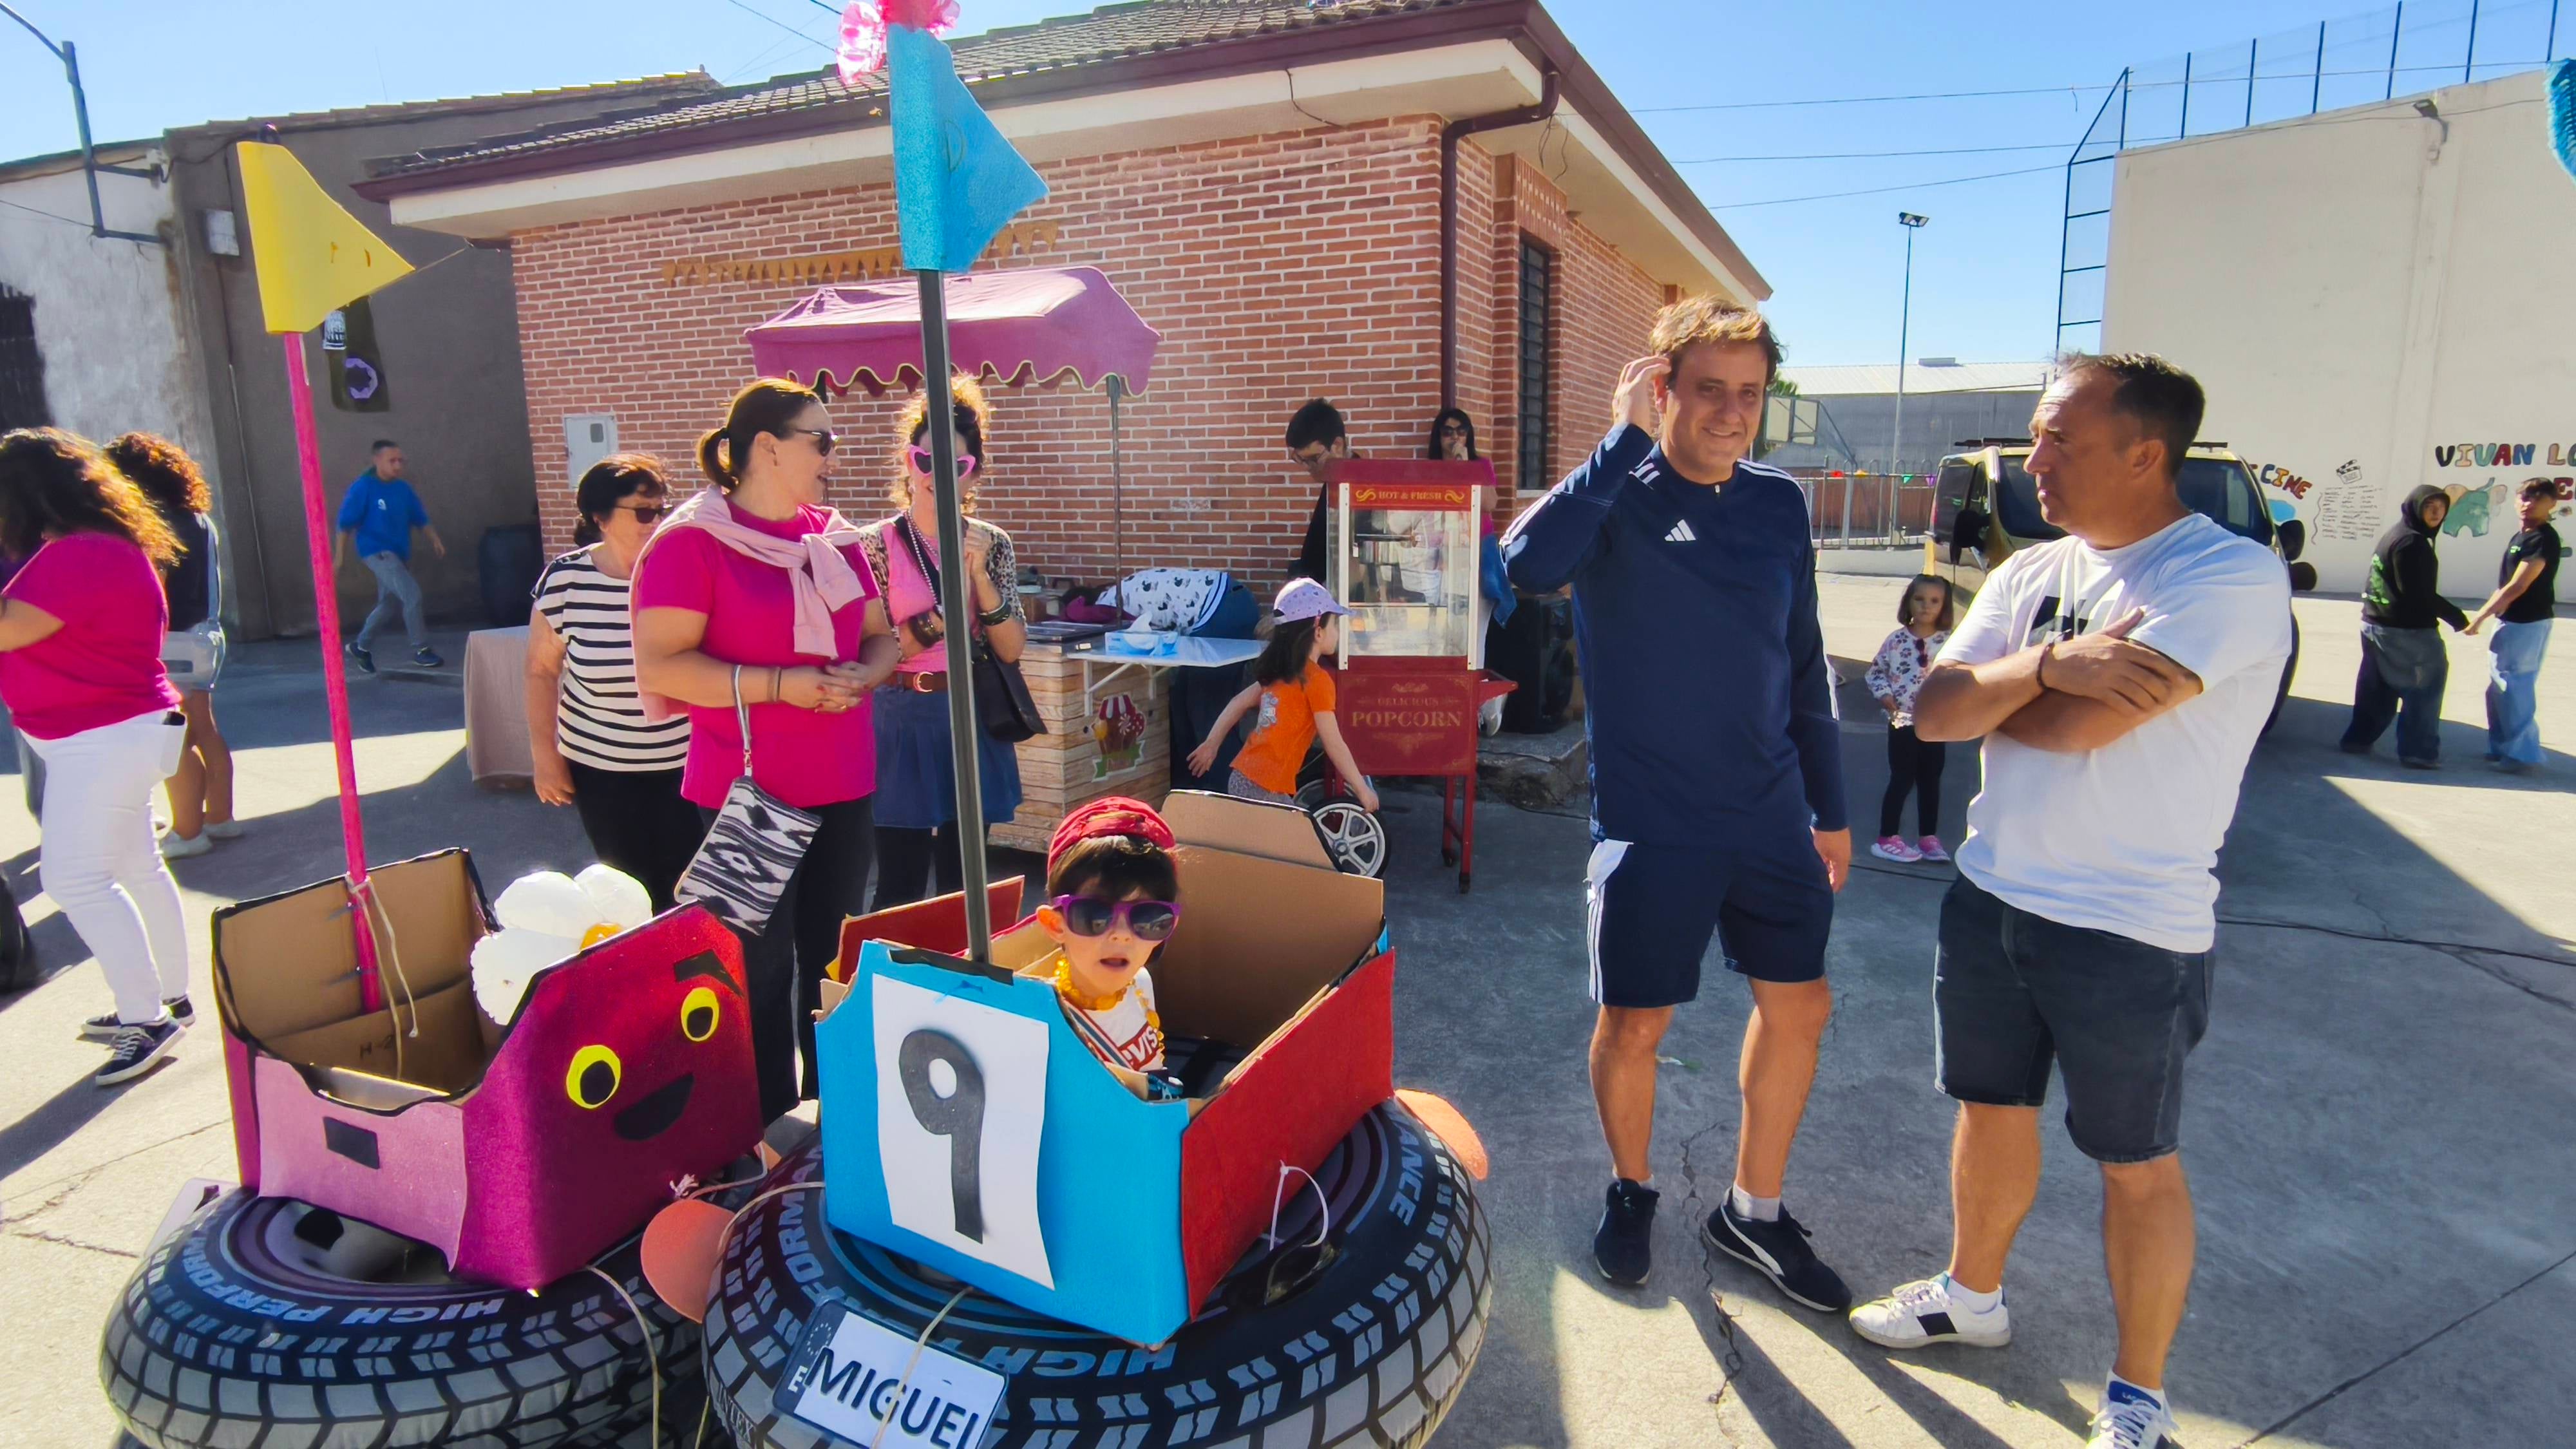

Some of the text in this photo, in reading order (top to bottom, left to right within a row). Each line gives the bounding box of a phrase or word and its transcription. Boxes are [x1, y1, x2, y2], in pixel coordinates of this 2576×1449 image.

[2435, 442, 2536, 467] VIVAN
[1411, 491, 1442, 500] FRESH
[2260, 464, 2313, 500] CINE
[1377, 697, 1439, 706] DELICIOUS
[1352, 711, 1463, 727] POPCORN
[899, 1029, 985, 1244] 9
[340, 1298, 505, 1325] HIGH
[981, 1341, 1177, 1377] HIGH
[788, 1365, 808, 1393] E
